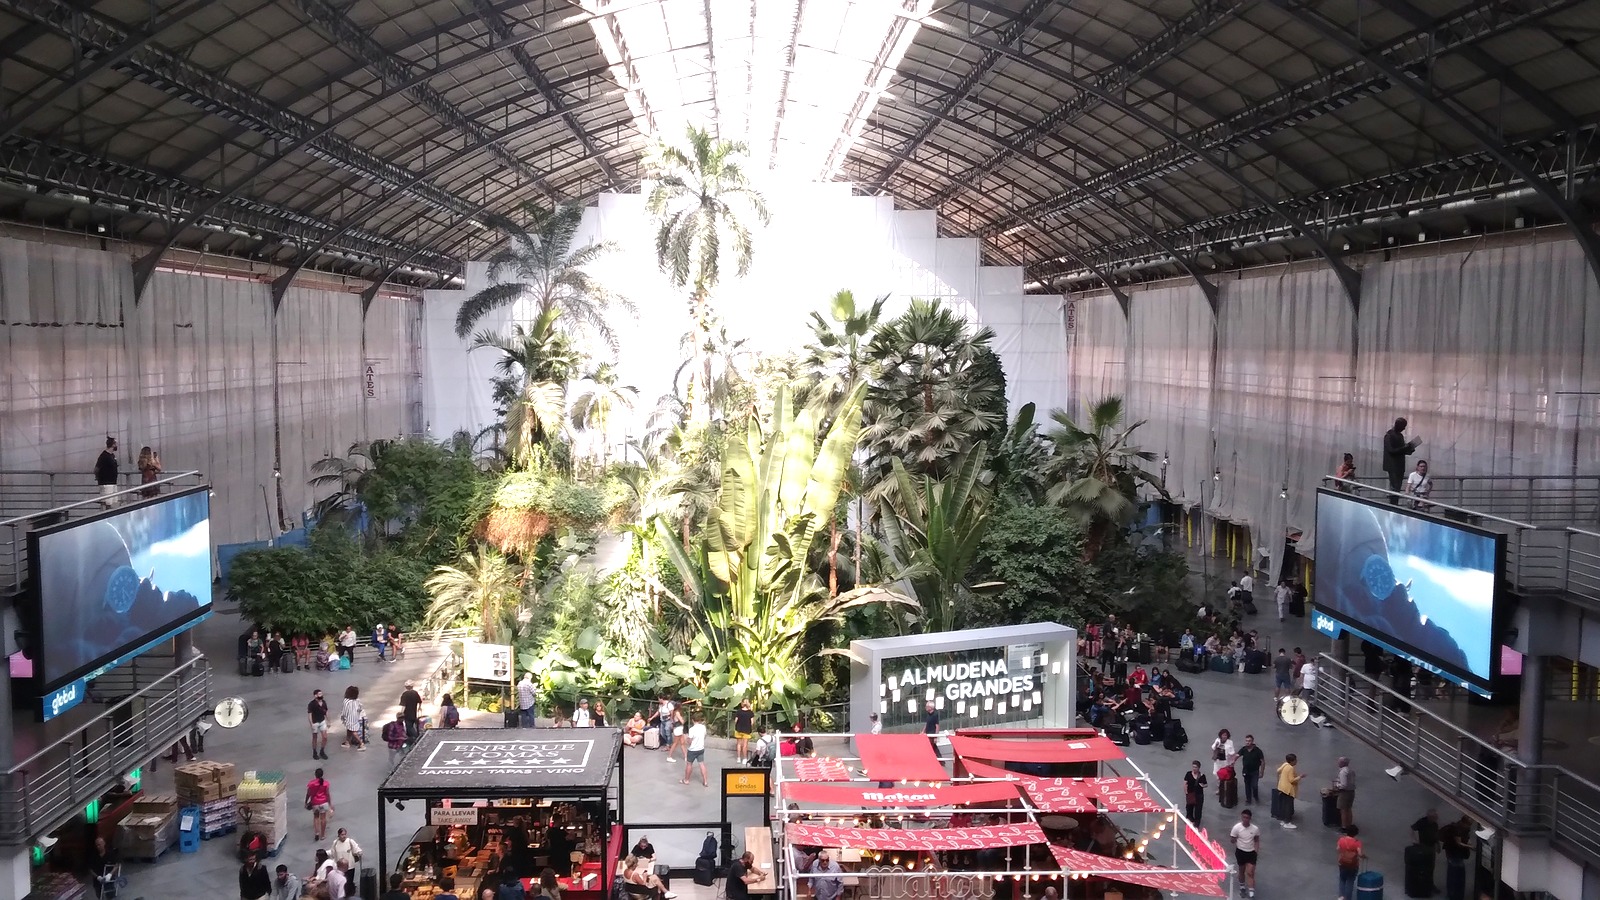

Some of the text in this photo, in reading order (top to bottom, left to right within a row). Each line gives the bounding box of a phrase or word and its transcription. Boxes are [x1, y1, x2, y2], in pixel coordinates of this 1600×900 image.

[366, 366, 375, 396] ATES
[900, 659, 1008, 687] ALMUDENA
[52, 685, 76, 715] global
[946, 675, 1034, 701] GRANDES
[451, 744, 575, 752] ENRIQUE
